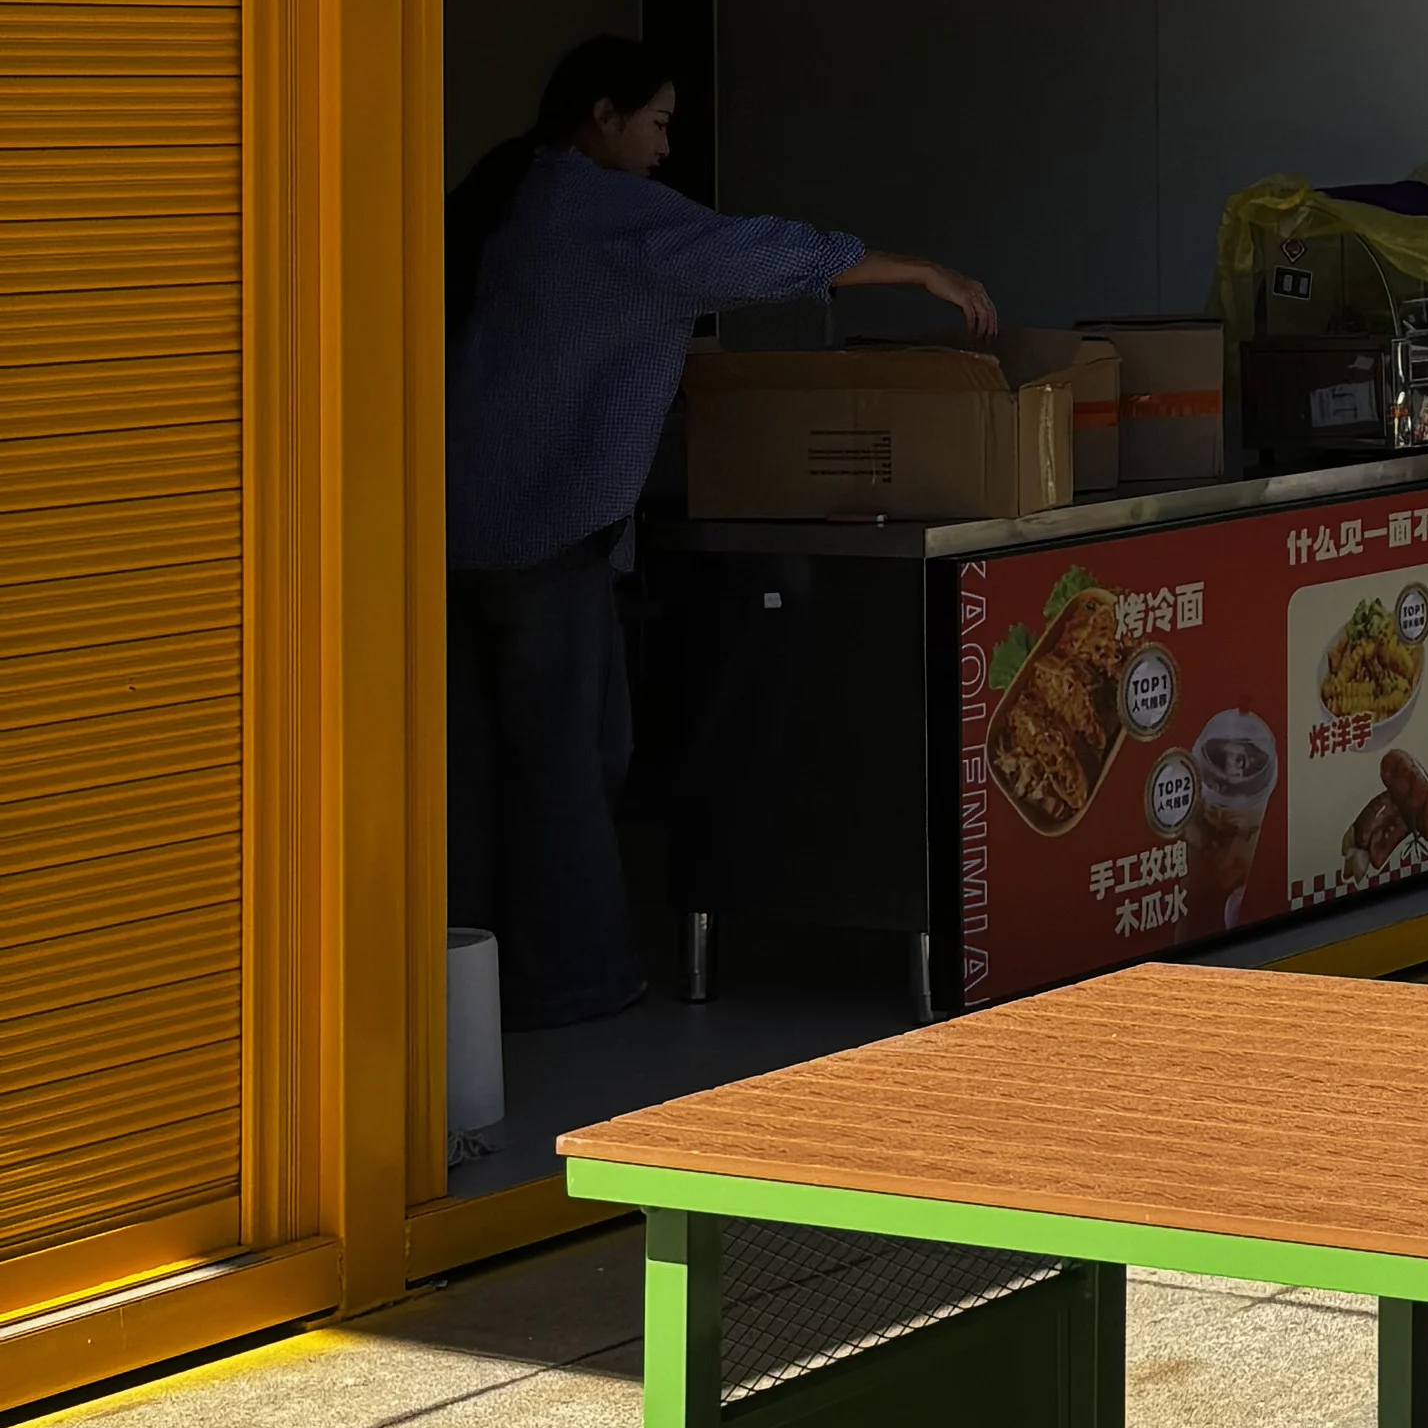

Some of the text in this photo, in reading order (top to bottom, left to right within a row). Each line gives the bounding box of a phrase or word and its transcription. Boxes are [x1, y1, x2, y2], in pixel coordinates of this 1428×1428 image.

[1115, 581, 1205, 641] 烤冷面
[1132, 675, 1168, 695] TOP1
[1309, 713, 1372, 759] 炸洋芋
[1158, 777, 1191, 797] TOP2
[1089, 840, 1188, 901] 手工玫瑰
[1115, 884, 1188, 938] 木瓜水
